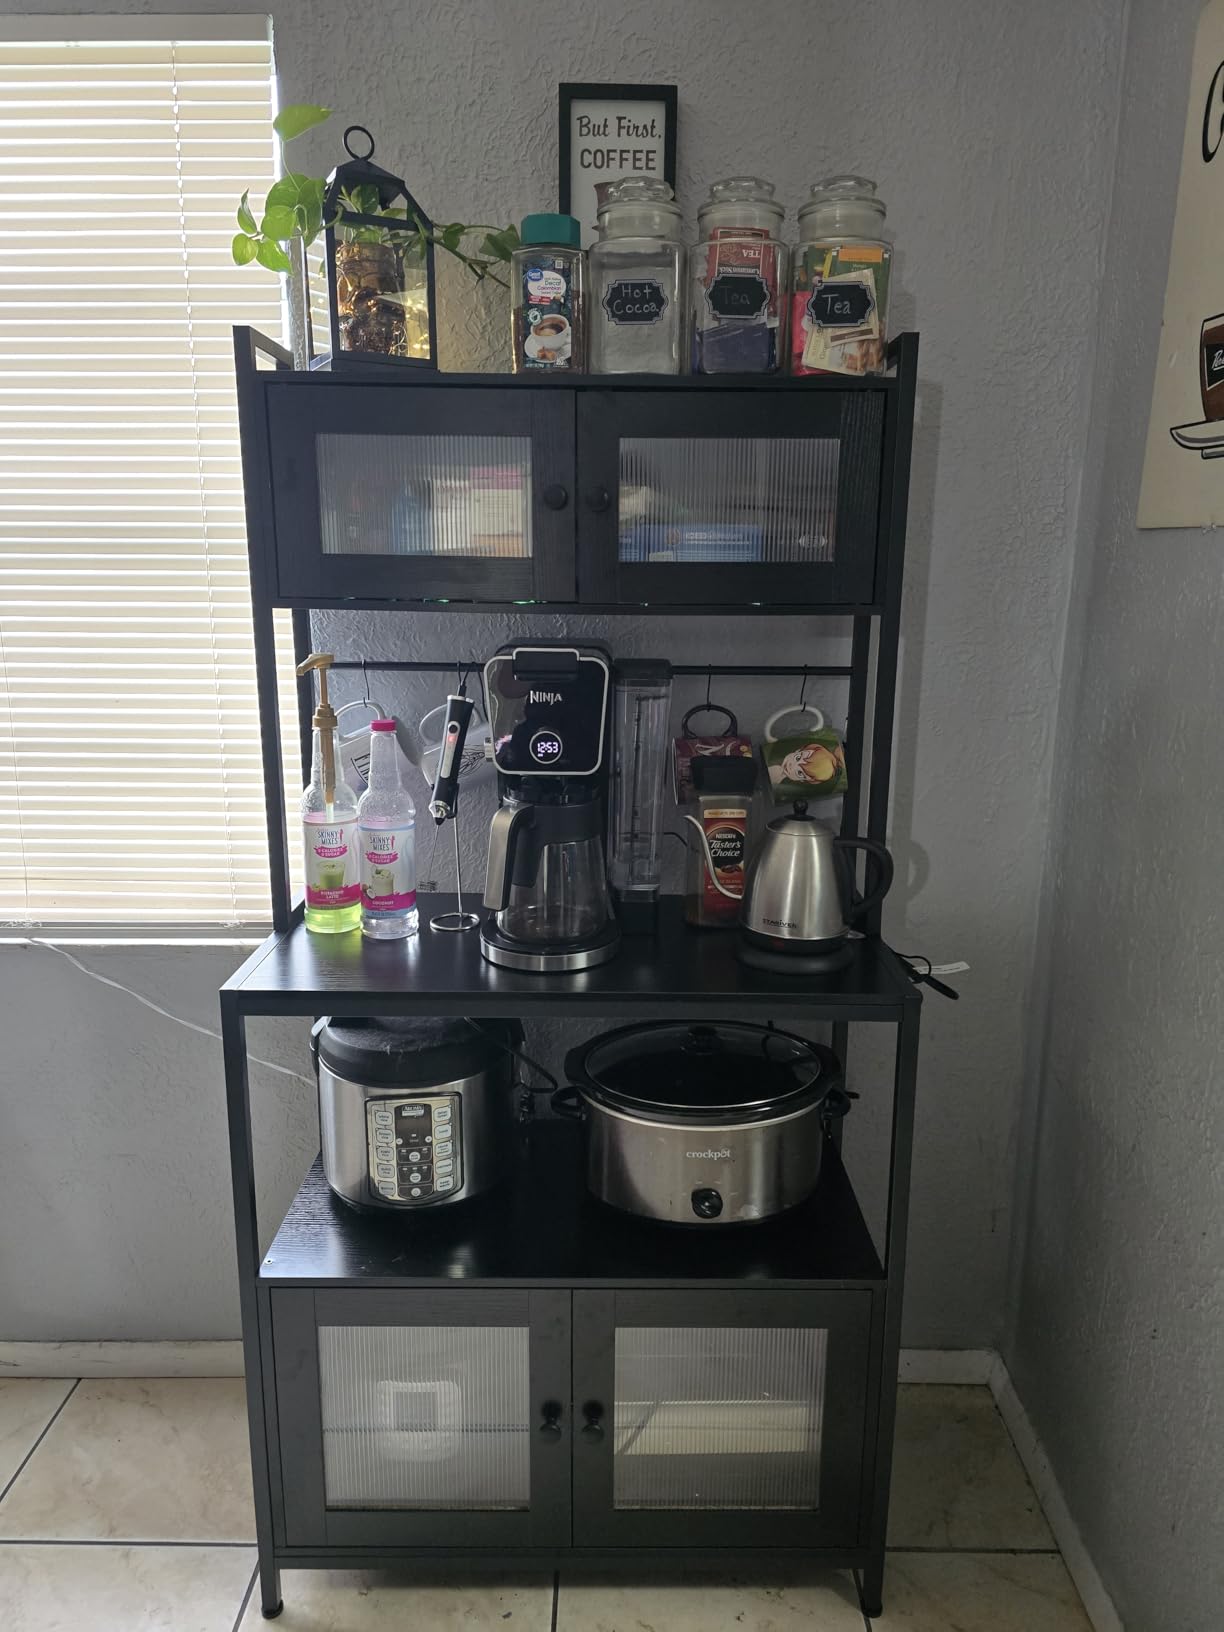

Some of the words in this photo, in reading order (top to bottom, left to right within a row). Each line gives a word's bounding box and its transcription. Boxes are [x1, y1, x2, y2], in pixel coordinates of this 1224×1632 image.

[576, 115, 609, 137] But
[580, 148, 657, 171] COFFEE
[742, 249, 761, 258] TEA
[622, 284, 652, 300] Hot
[720, 285, 750, 305] Tea
[613, 300, 659, 314] Cocoa
[821, 293, 852, 315] Tea
[530, 690, 562, 706] NINJA
[537, 742, 559, 753] 12:53
[318, 831, 338, 839] SKINNY
[370, 836, 390, 844] SKINNY
[710, 840, 741, 849] Taster's
[711, 849, 740, 857] Choice
